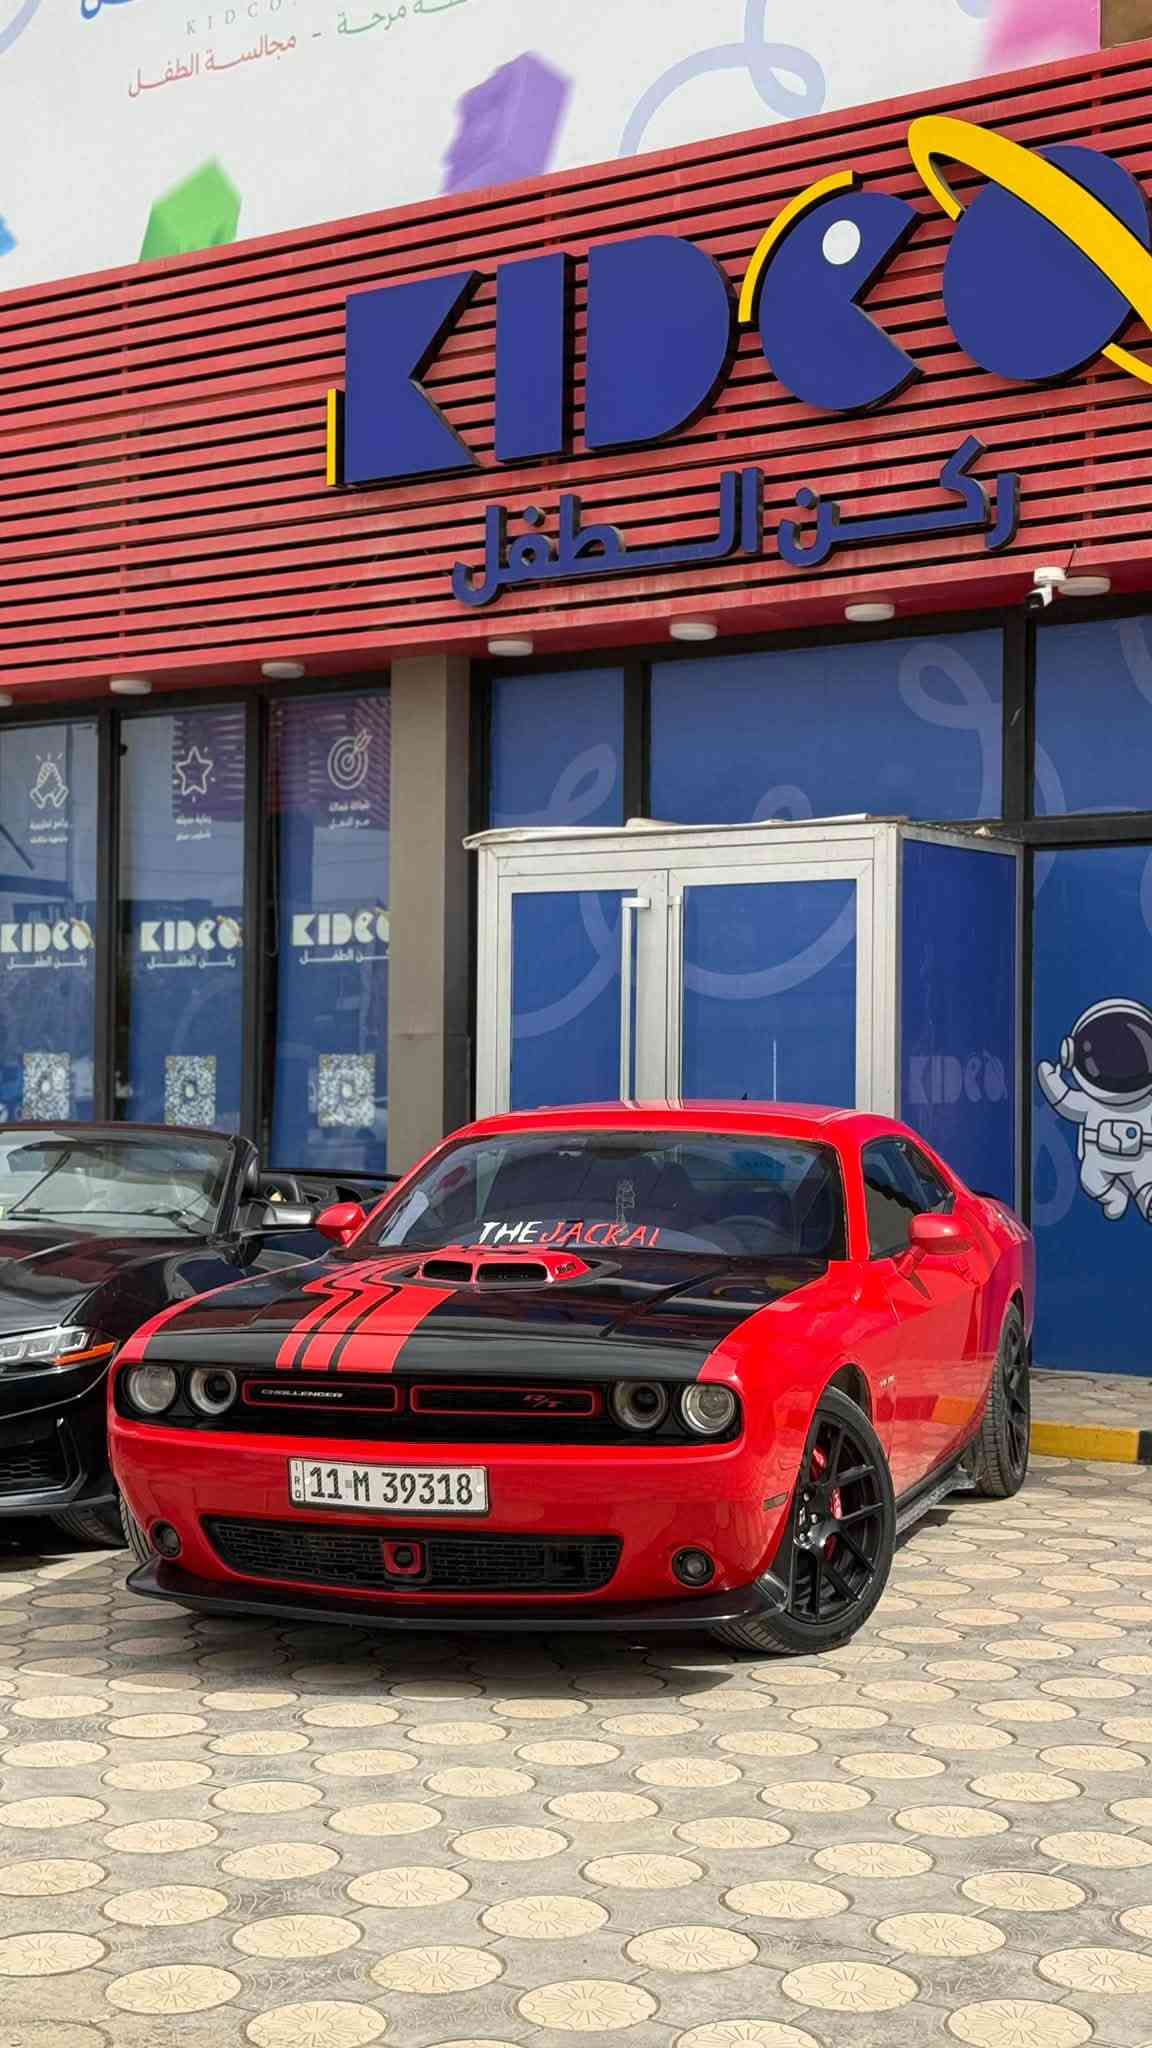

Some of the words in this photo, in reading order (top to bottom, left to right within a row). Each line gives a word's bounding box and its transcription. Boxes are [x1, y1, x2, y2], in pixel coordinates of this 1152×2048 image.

[204, 34, 297, 71] مجالسة
[128, 53, 199, 97] الطفل
[777, 435, 1020, 567] ركن
[451, 466, 765, 607] الطفل
[479, 1220, 543, 1244] THE
[309, 1466, 343, 1499] 11
[352, 1469, 371, 1502] M
[381, 1471, 473, 1505] 39318
